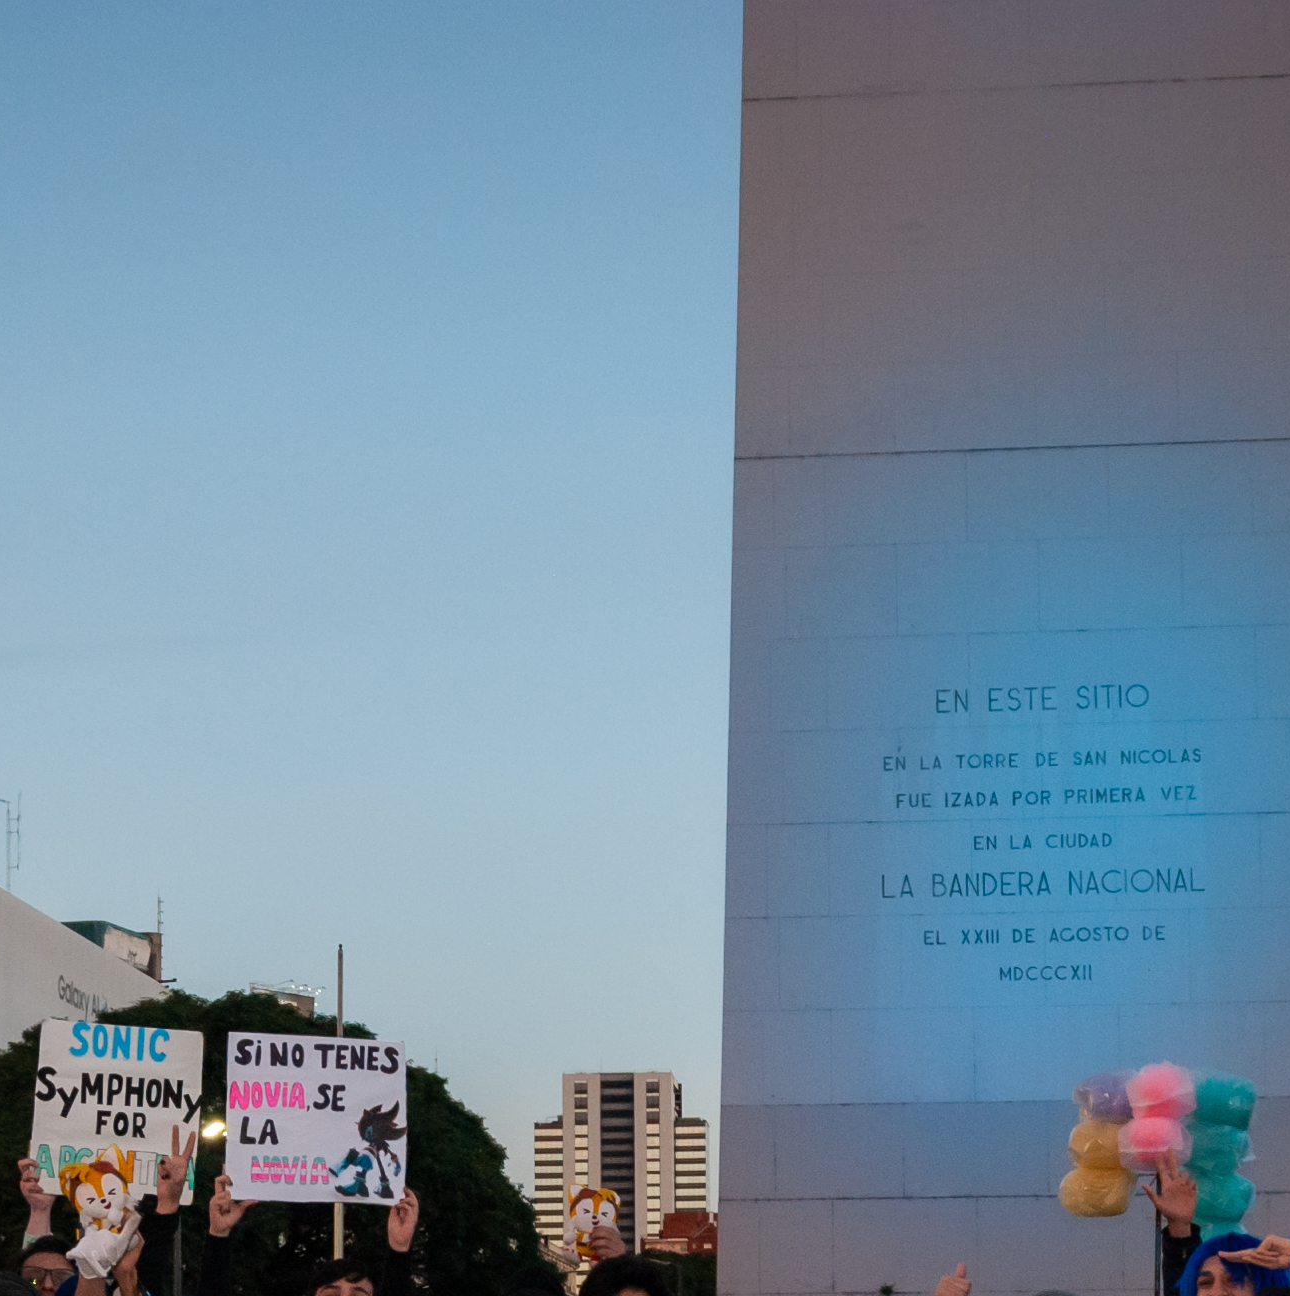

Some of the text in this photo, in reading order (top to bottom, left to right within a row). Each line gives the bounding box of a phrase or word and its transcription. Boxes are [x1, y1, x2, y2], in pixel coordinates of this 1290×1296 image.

[936, 683, 1150, 713] EN ESTE SITIO
[883, 748, 1202, 771] EN LA TORRE DE SAN NICOLAS
[896, 785, 1198, 809] FUE IZADA POR PRIMERA VEZ
[973, 832, 1113, 850] EN LA CIUDAD
[881, 867, 1206, 898] LA BANDERA NACIONAL
[923, 925, 1166, 946] EL XXIII DE AGOSTO DE
[999, 963, 1093, 981] MDCCCXII
[69, 1021, 171, 1063] SONIC
[270, 1042, 306, 1068] NO
[314, 1043, 400, 1075] TENES
[313, 1084, 346, 1112] SE
[95, 1111, 147, 1139] FOR
[239, 1116, 280, 1145] LA
